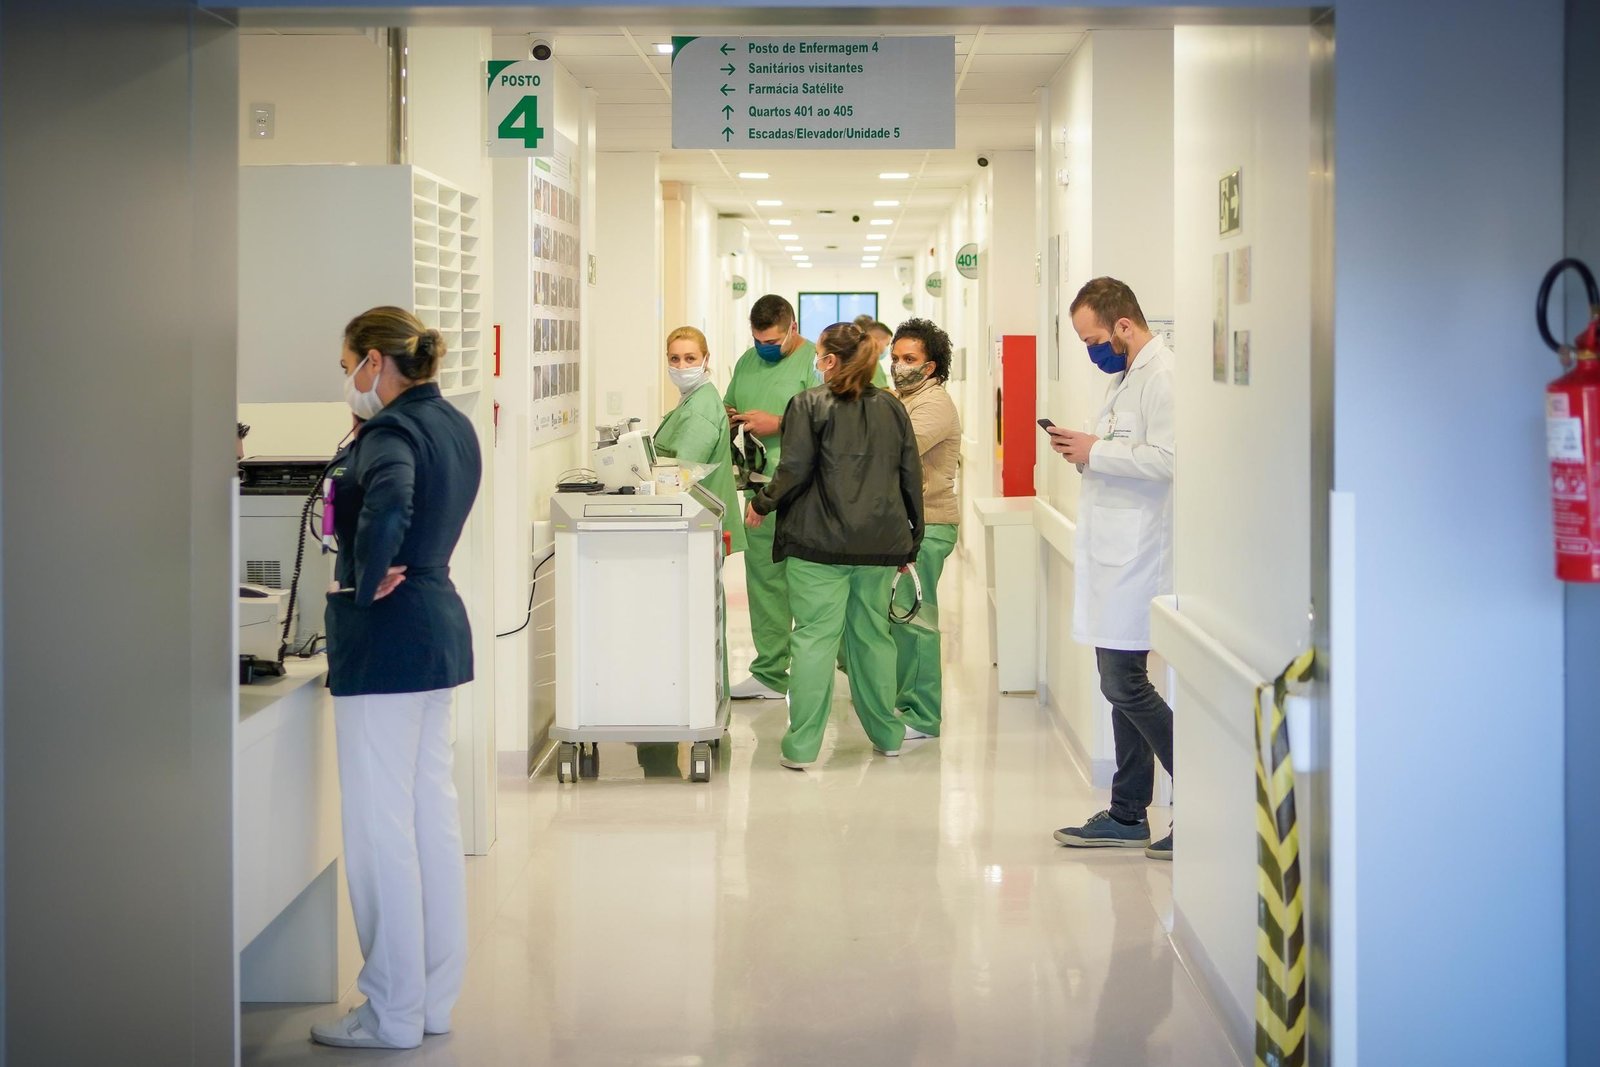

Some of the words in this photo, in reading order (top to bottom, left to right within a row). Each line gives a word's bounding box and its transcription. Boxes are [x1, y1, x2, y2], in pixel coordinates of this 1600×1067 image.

[748, 42, 779, 54] Posto
[782, 42, 796, 54] de
[799, 42, 868, 56] Enfermagem
[872, 41, 879, 53] 4
[748, 61, 805, 74] Sanitários
[809, 61, 864, 74] visitantes
[501, 75, 541, 87] POSTO
[748, 82, 799, 95] Farmácia
[802, 82, 844, 95] Satélite
[748, 105, 791, 118] Quartos
[794, 105, 813, 117] 401
[817, 107, 831, 117] ao
[833, 104, 854, 117] 405
[498, 95, 544, 148] 4
[748, 127, 890, 140] Escadas/Elevador/Unidade
[893, 127, 901, 139] 5
[957, 254, 978, 267] 401
